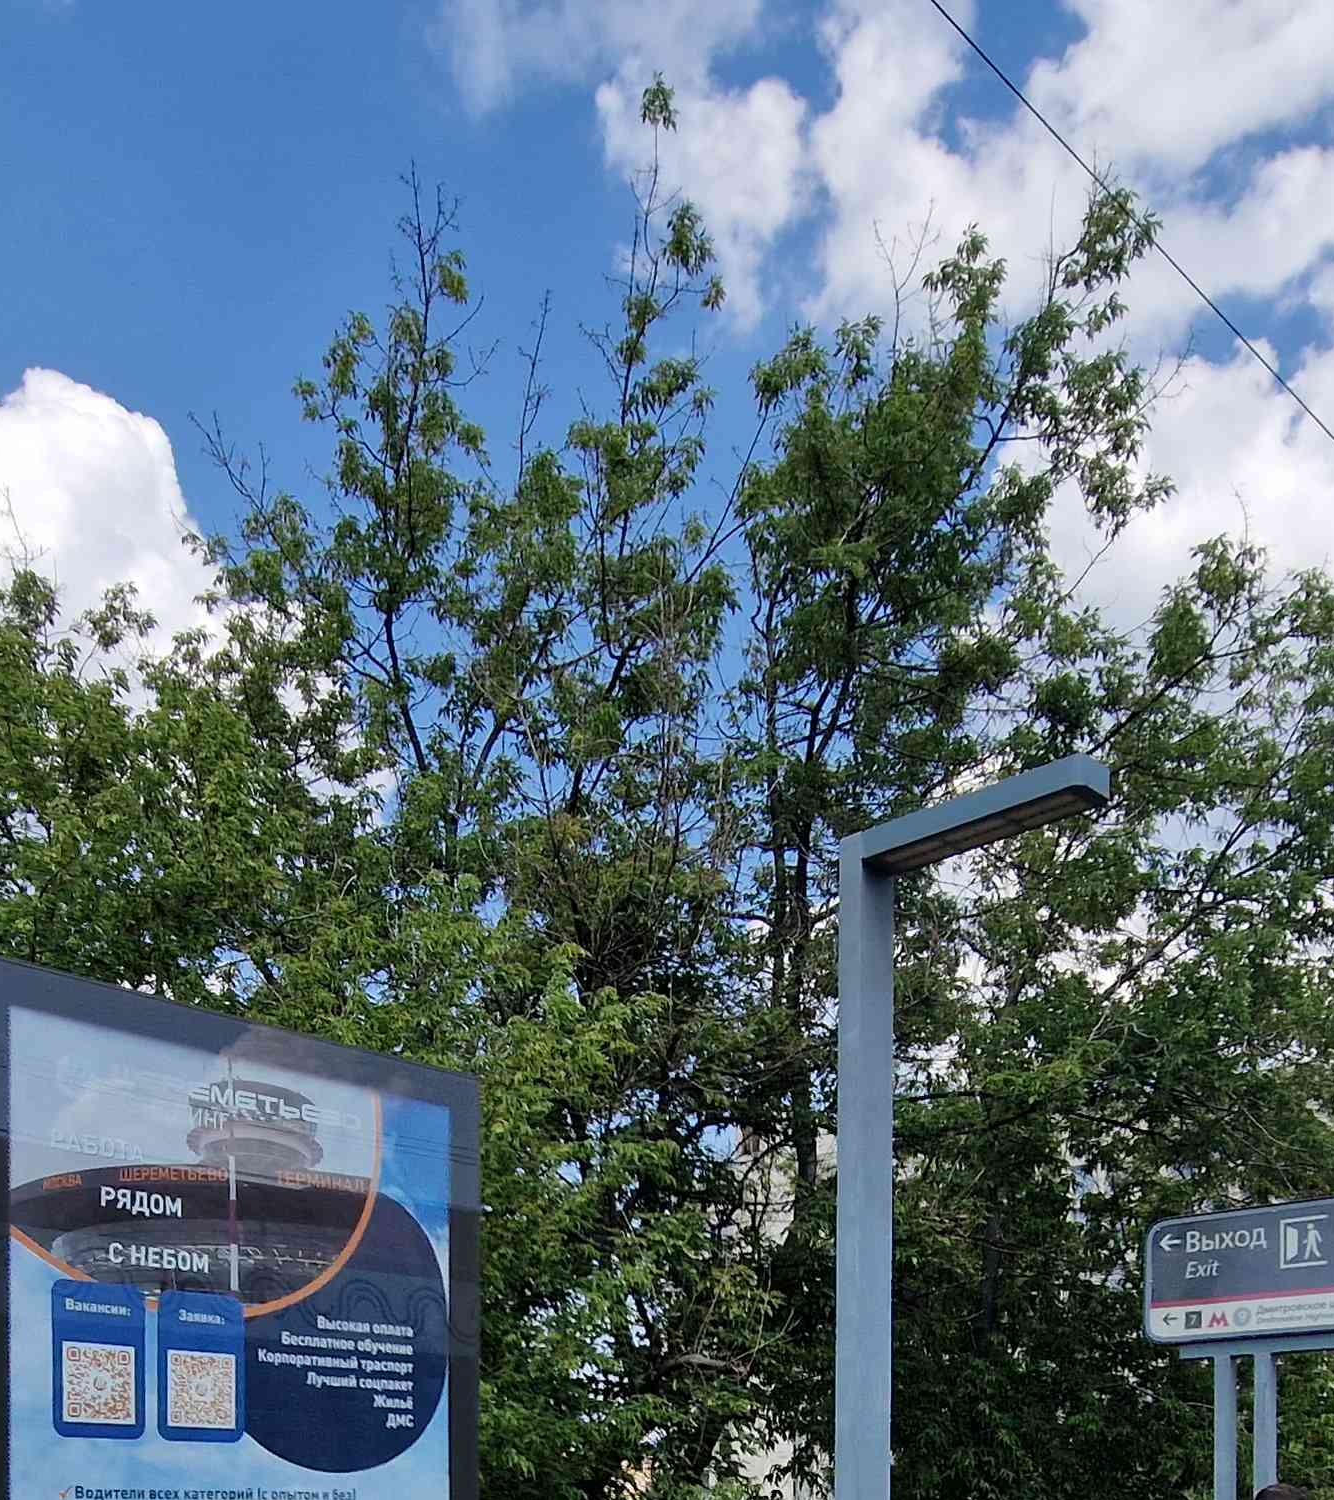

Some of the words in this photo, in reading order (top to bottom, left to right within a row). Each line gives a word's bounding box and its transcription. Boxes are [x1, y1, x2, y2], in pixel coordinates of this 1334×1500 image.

[119, 1167, 228, 1183] ШЕРЕМЕТЬЕВО
[100, 1186, 183, 1217] РЯДОМ
[1185, 1227, 1267, 1253] Выход
[108, 1242, 124, 1264] С
[130, 1245, 210, 1273] НЕБОМ
[1184, 1259, 1220, 1279] Exit
[65, 1298, 132, 1317] Вакансии:
[178, 1309, 226, 1325] Заявка:
[317, 1315, 369, 1334] Высокая
[372, 1323, 414, 1337] оплата
[281, 1331, 355, 1349] Бесплатное
[357, 1338, 414, 1355] обучение
[258, 1348, 359, 1369] Корпоративный
[306, 1371, 357, 1388] Лучший
[359, 1377, 414, 1392] соцпакет
[385, 1413, 414, 1429] ДМС
[75, 1485, 145, 1500] Водители
[149, 1489, 180, 1500] всех
[271, 1490, 319, 1500] опытом
